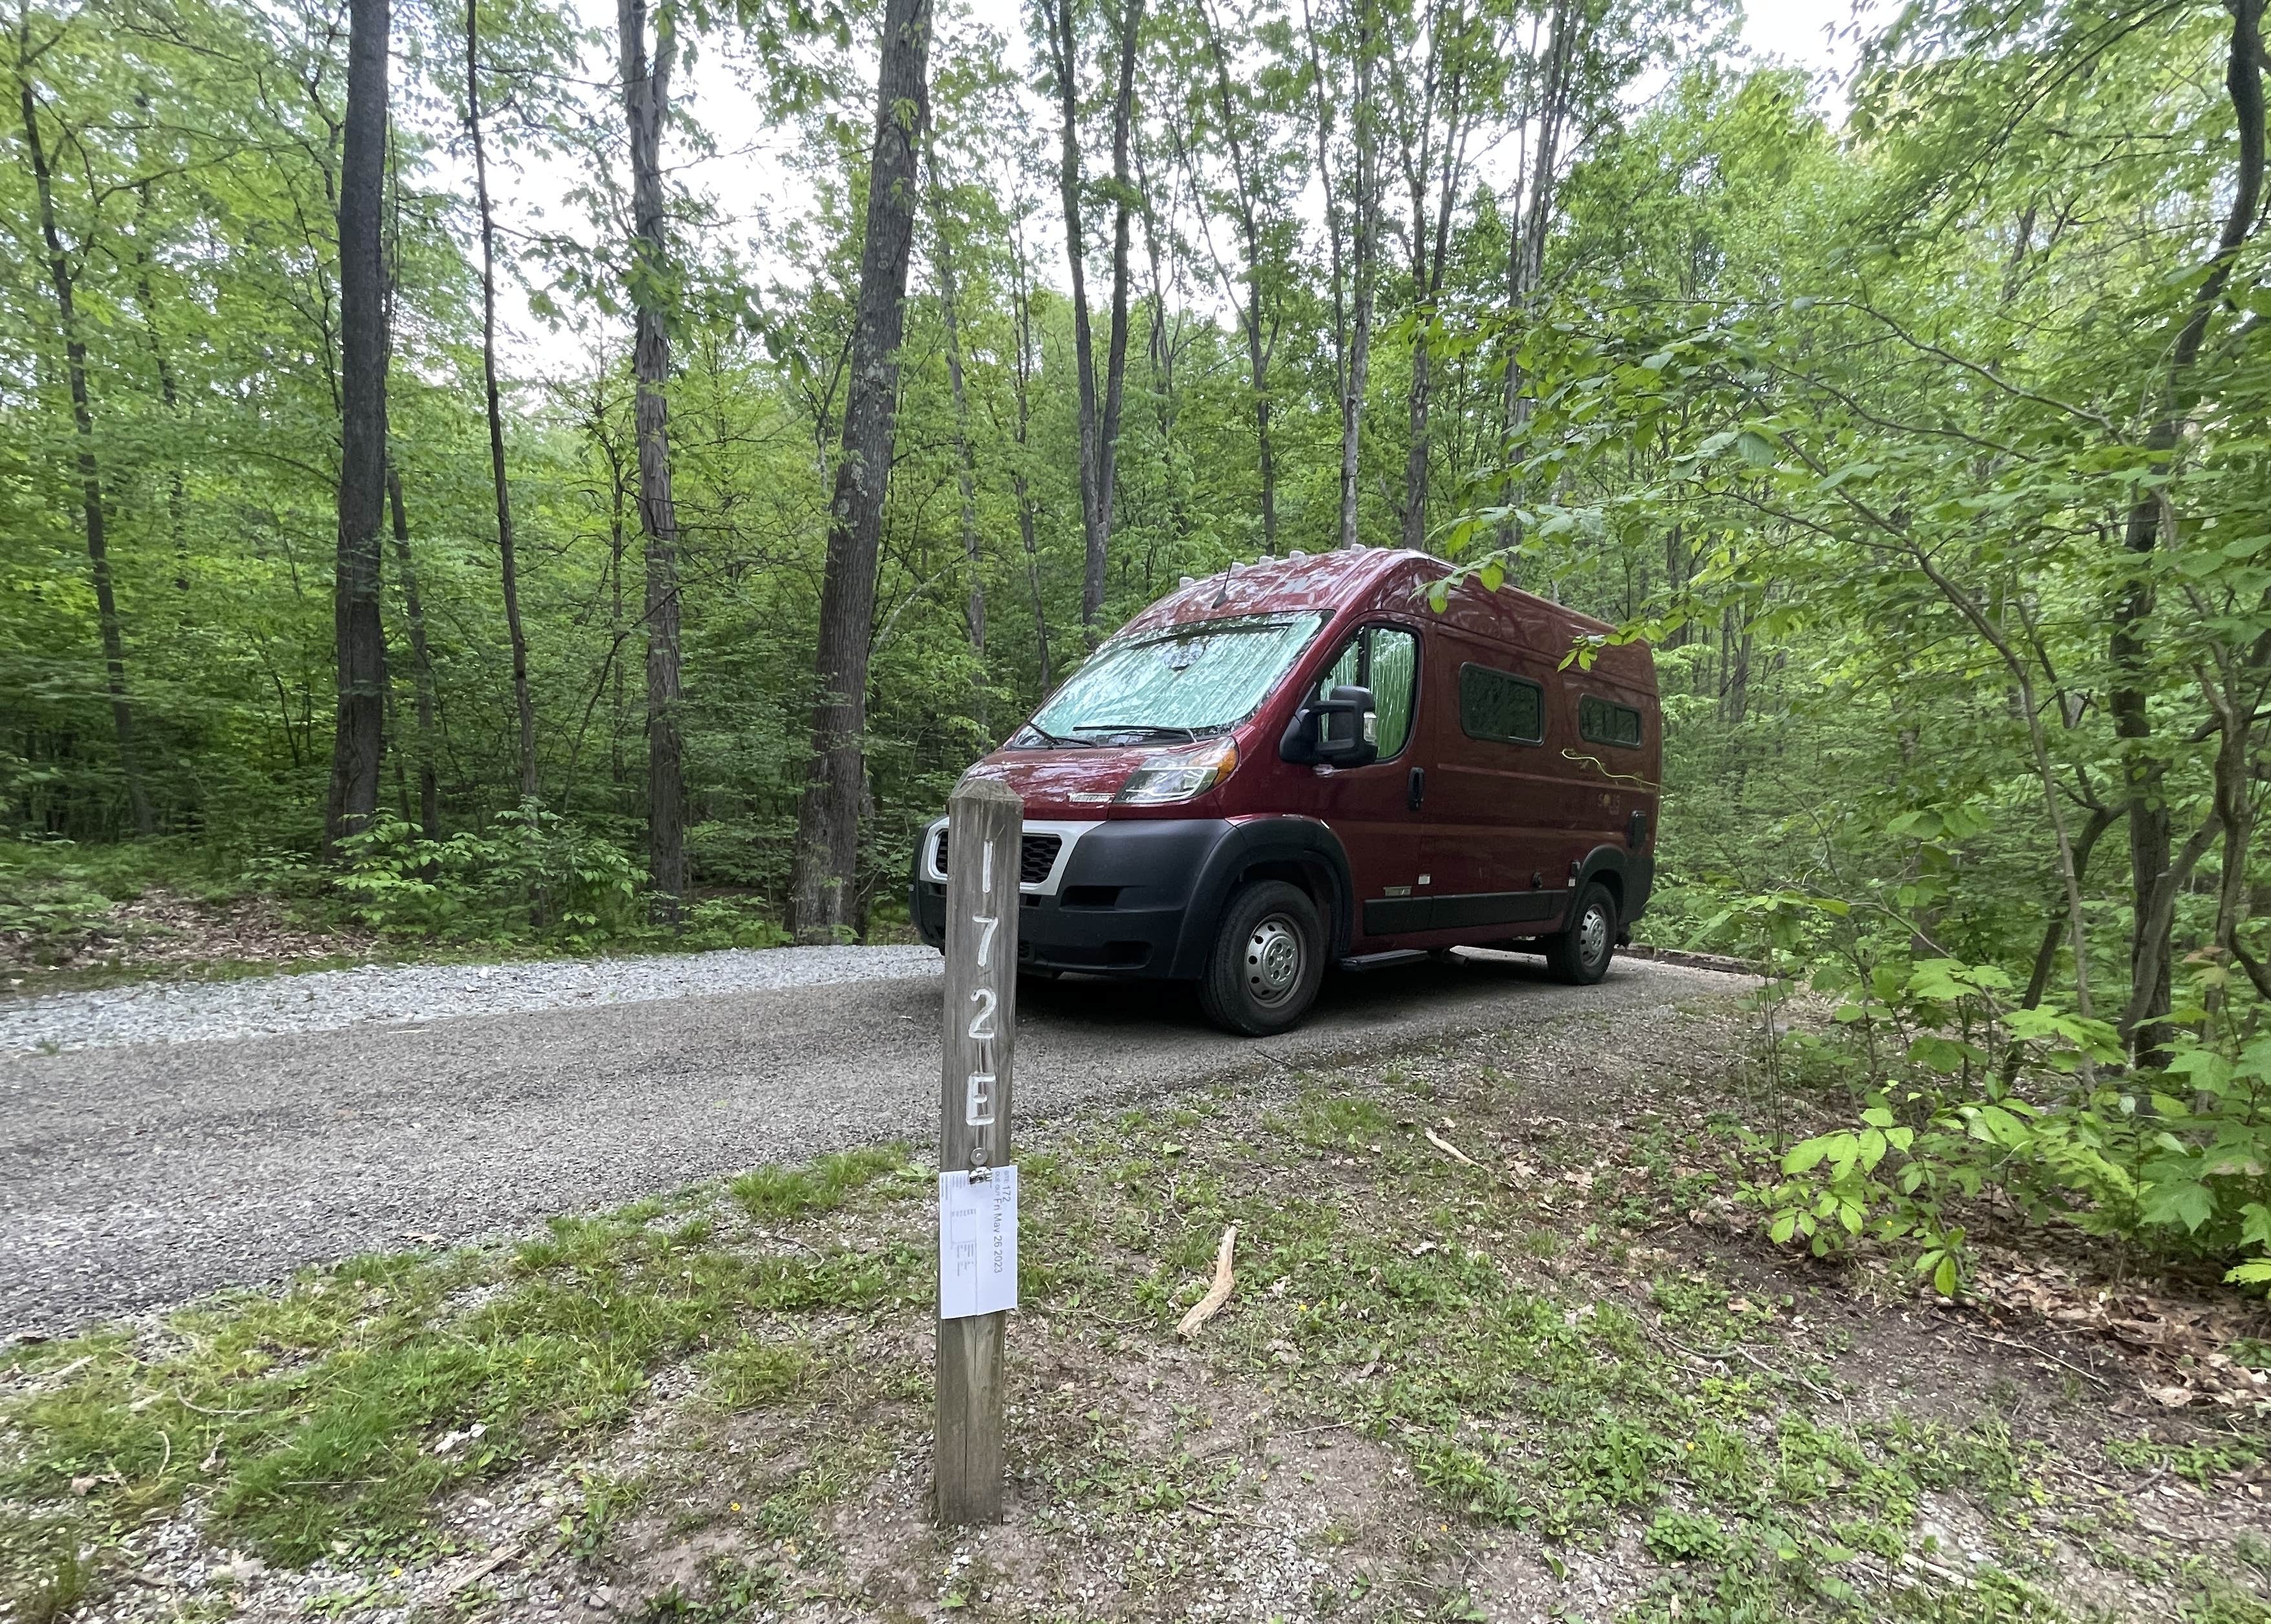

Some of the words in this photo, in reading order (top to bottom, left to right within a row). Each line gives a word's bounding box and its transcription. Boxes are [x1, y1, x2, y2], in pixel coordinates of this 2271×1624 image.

[1002, 1185, 1011, 1202] 172
[993, 1198, 1002, 1210] Fri
[993, 1214, 1002, 1233] May
[994, 1235, 1003, 1248] 26
[994, 1250, 1003, 1273] 2023
